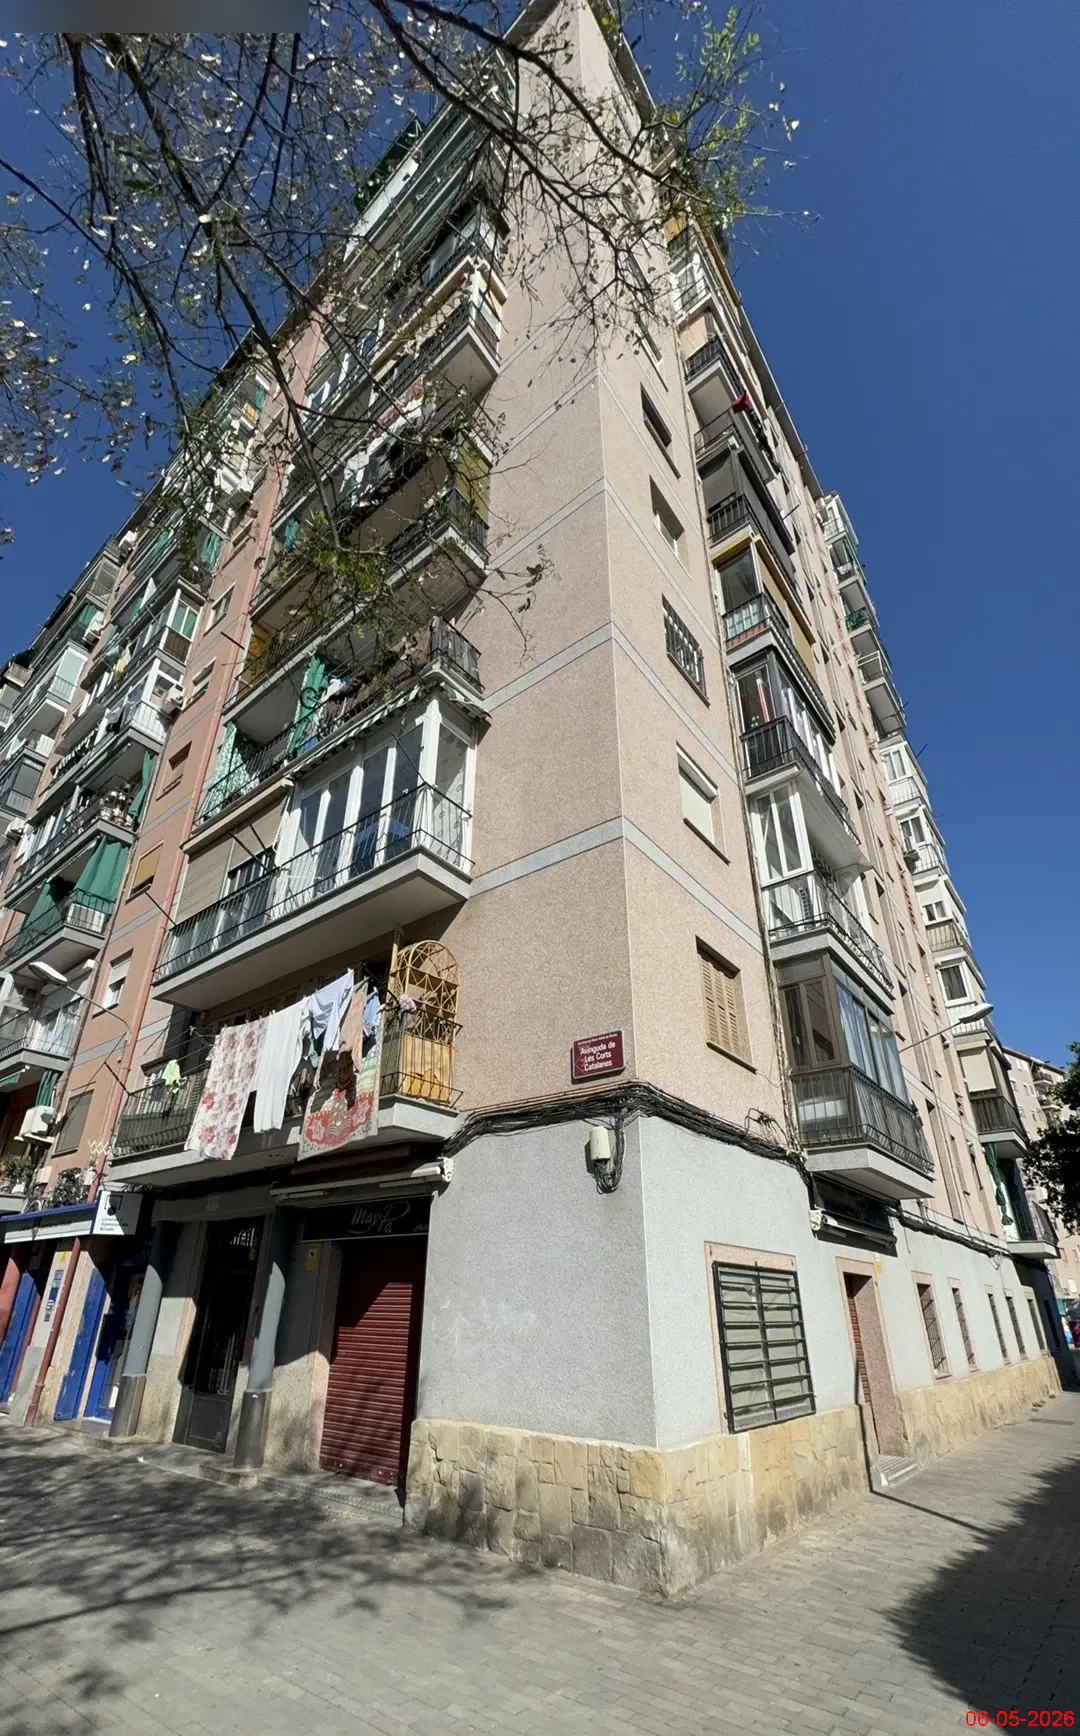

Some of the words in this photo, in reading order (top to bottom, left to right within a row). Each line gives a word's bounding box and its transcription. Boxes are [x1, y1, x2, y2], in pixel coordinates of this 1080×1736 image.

[580, 1043, 607, 1056] Avinguda
[607, 1040, 616, 1049] de
[584, 1055, 595, 1063] Les
[596, 1051, 612, 1060] Corts
[584, 1060, 613, 1071] Catalanes
